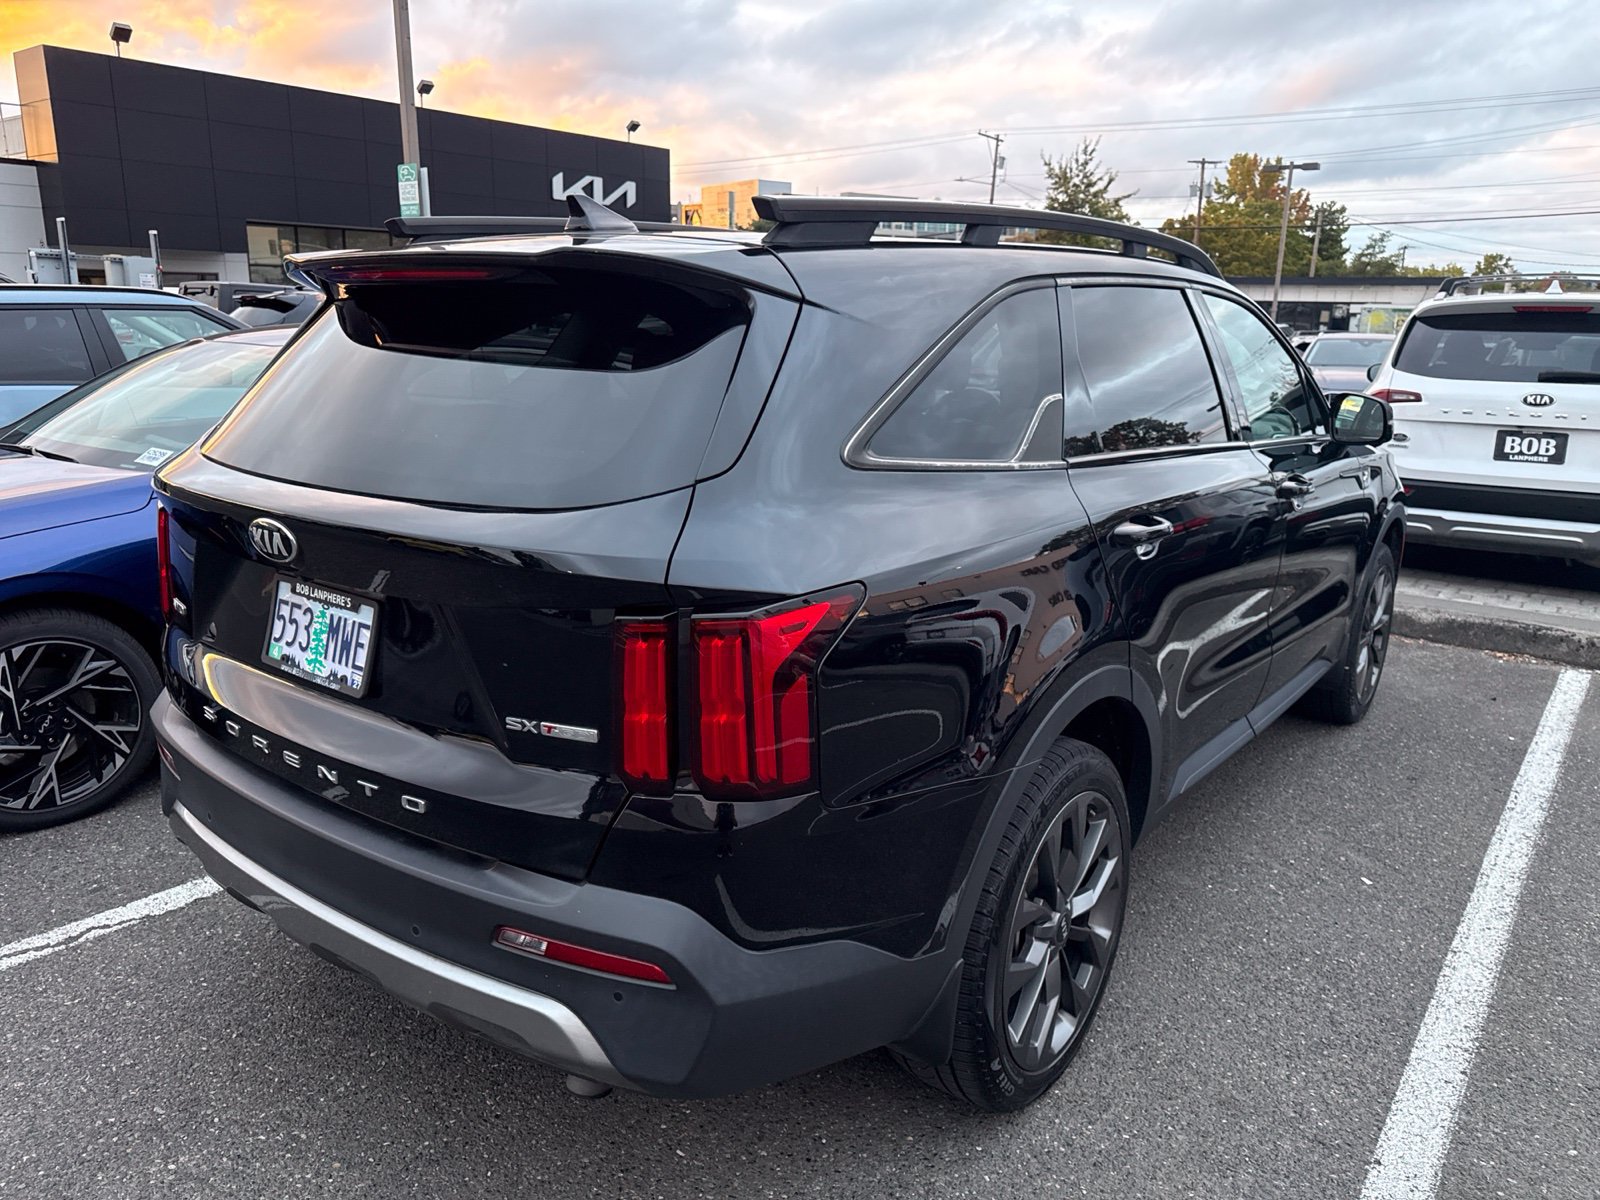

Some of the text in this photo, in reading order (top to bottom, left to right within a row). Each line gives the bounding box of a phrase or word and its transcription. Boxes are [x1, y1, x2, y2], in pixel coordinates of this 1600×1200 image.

[1525, 394, 1551, 405] KIA
[1504, 436, 1557, 456] BOB
[1509, 454, 1548, 462] LANPHERE
[251, 526, 289, 557] KIA
[295, 582, 352, 608] BOB LANPHERE'S
[273, 598, 371, 672] 553 MWE
[352, 679, 362, 690] 27
[505, 716, 539, 735] SX
[202, 704, 427, 815] SORENTO
